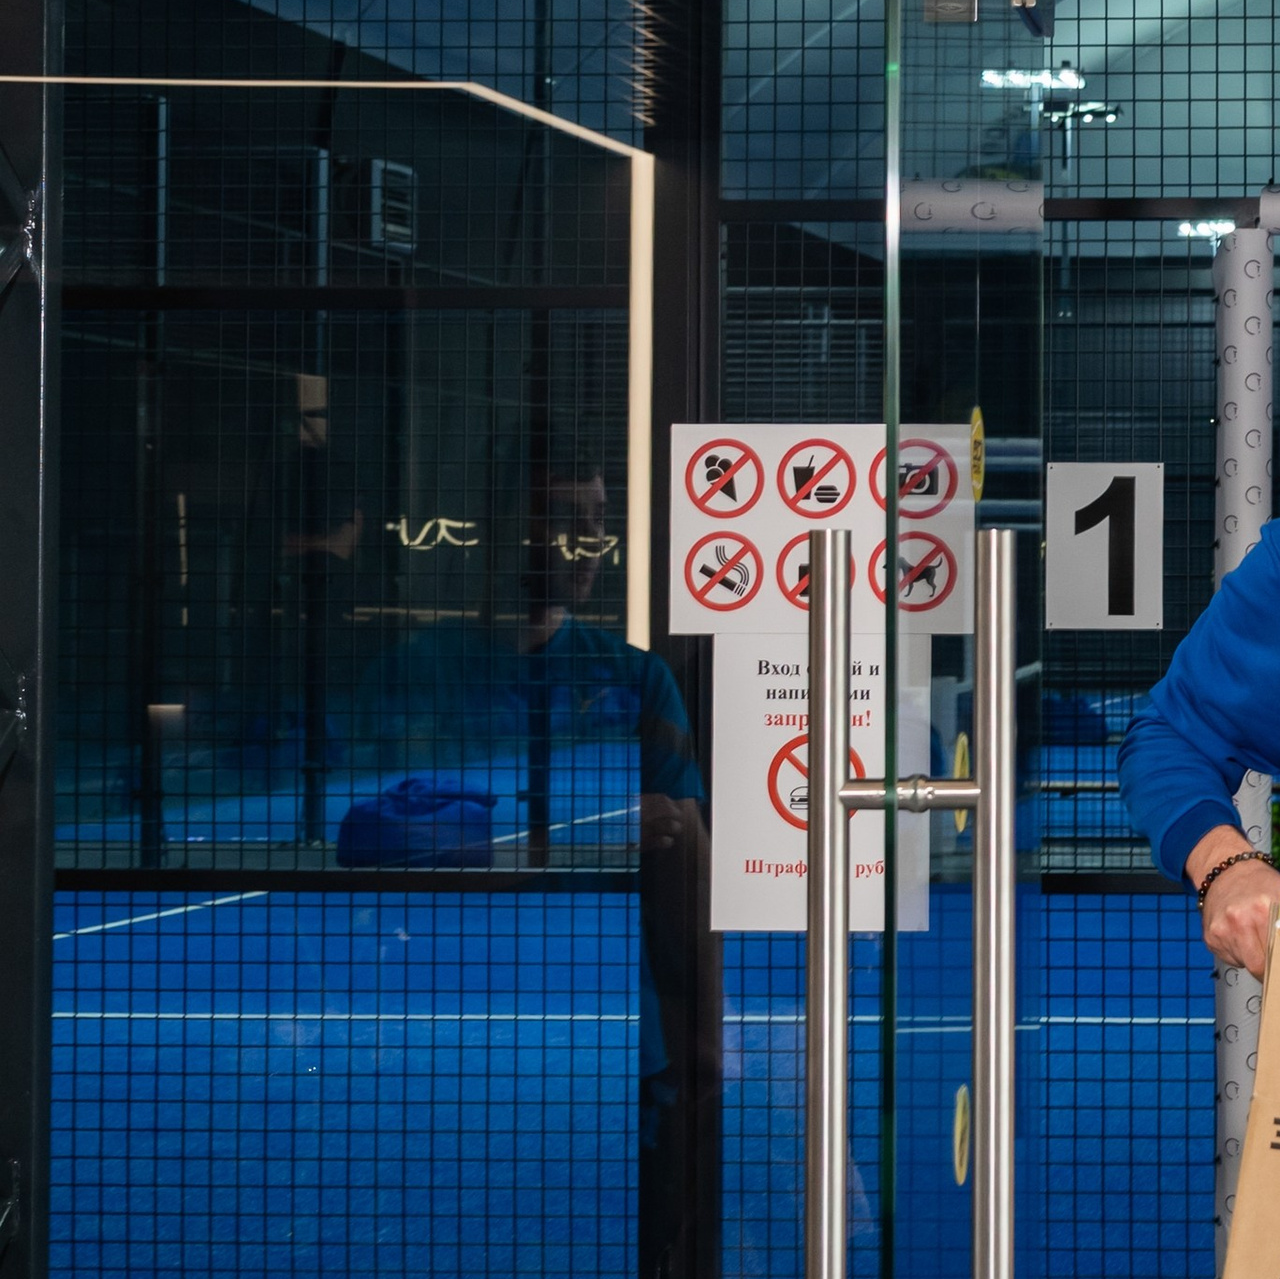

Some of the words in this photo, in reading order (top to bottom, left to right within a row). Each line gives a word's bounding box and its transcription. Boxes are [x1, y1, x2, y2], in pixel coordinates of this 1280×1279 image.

[1074, 475, 1137, 616] 1
[757, 660, 801, 677] Вход
[744, 859, 808, 878] Штраф
